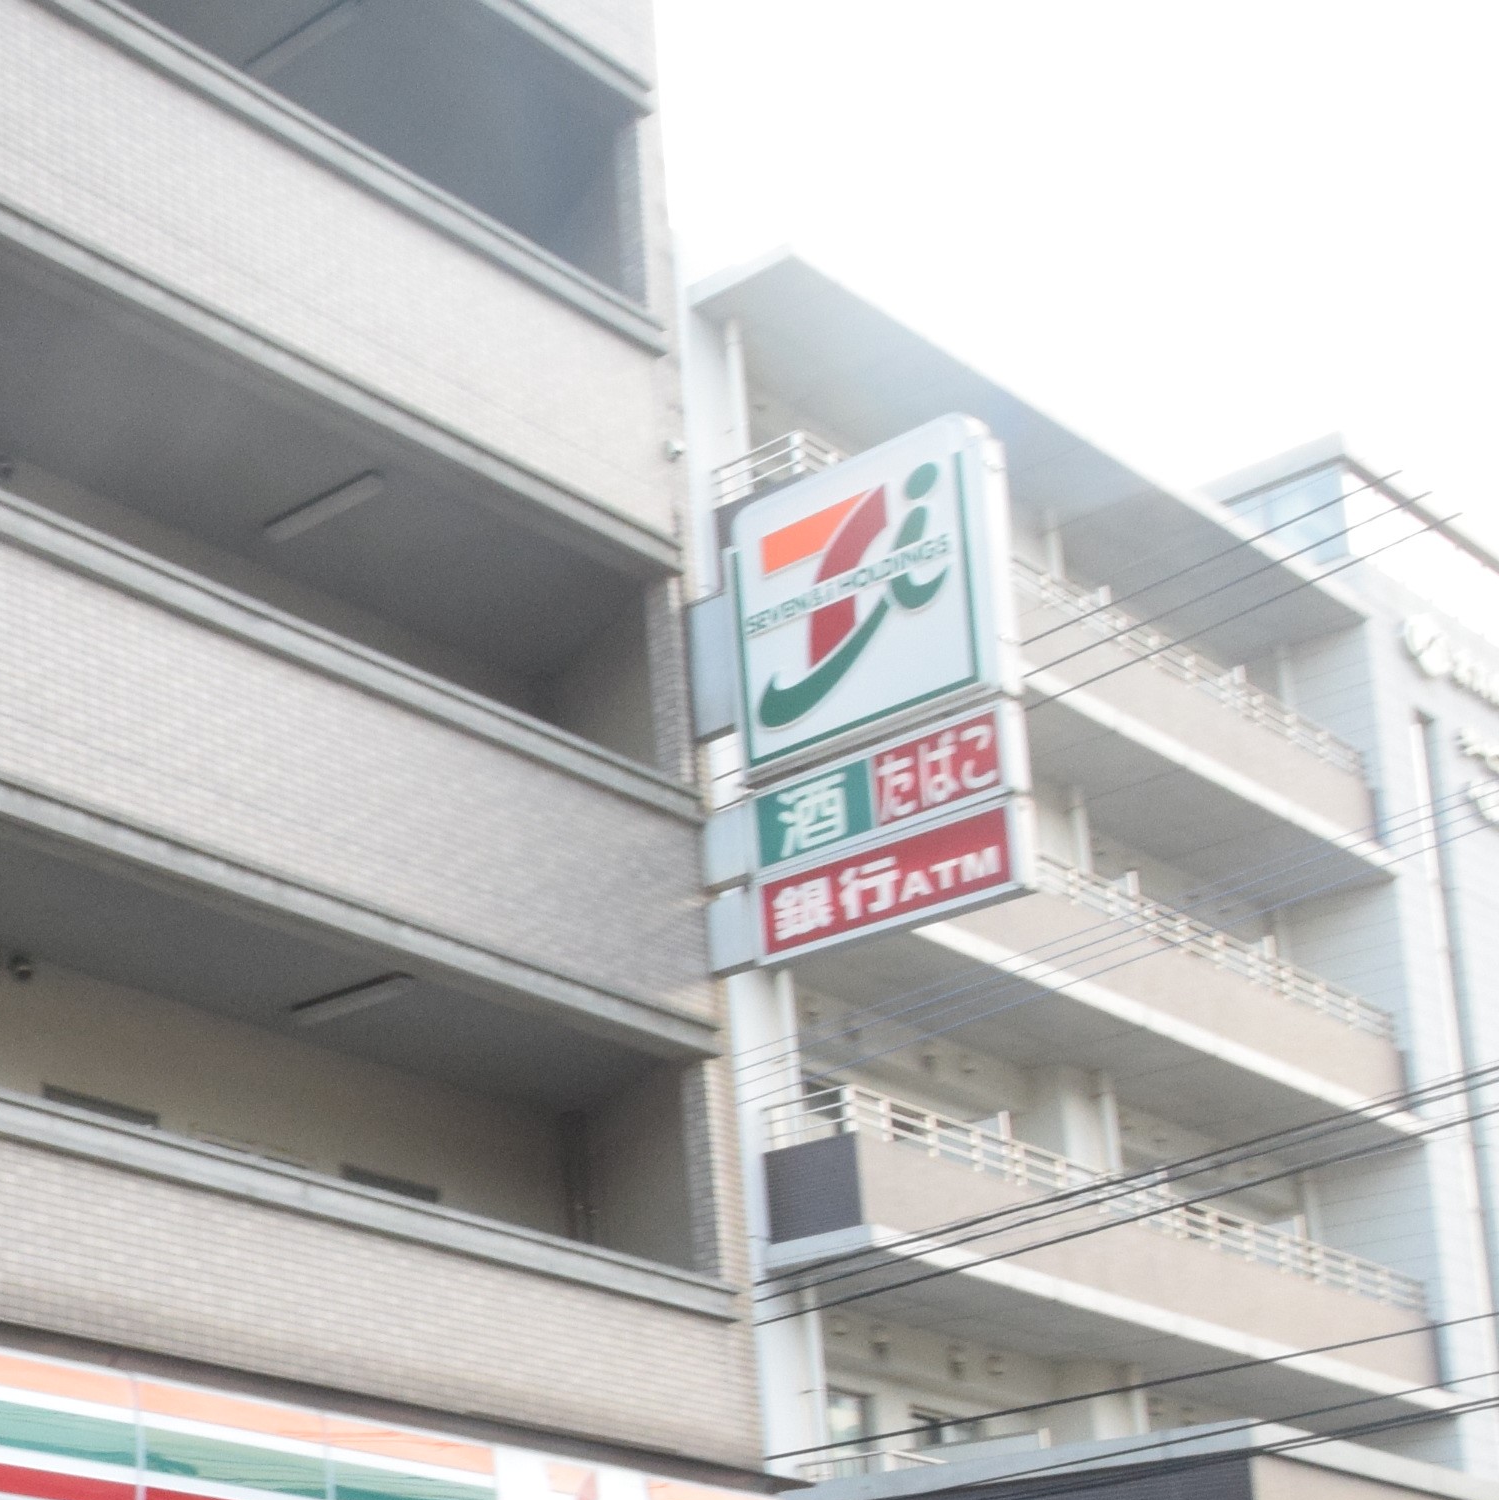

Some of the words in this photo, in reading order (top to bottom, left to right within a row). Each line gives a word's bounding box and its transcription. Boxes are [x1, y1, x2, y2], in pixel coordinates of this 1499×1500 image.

[838, 533, 950, 592] HOLDINGS
[875, 720, 998, 822] たばこ
[780, 772, 848, 859] 酒
